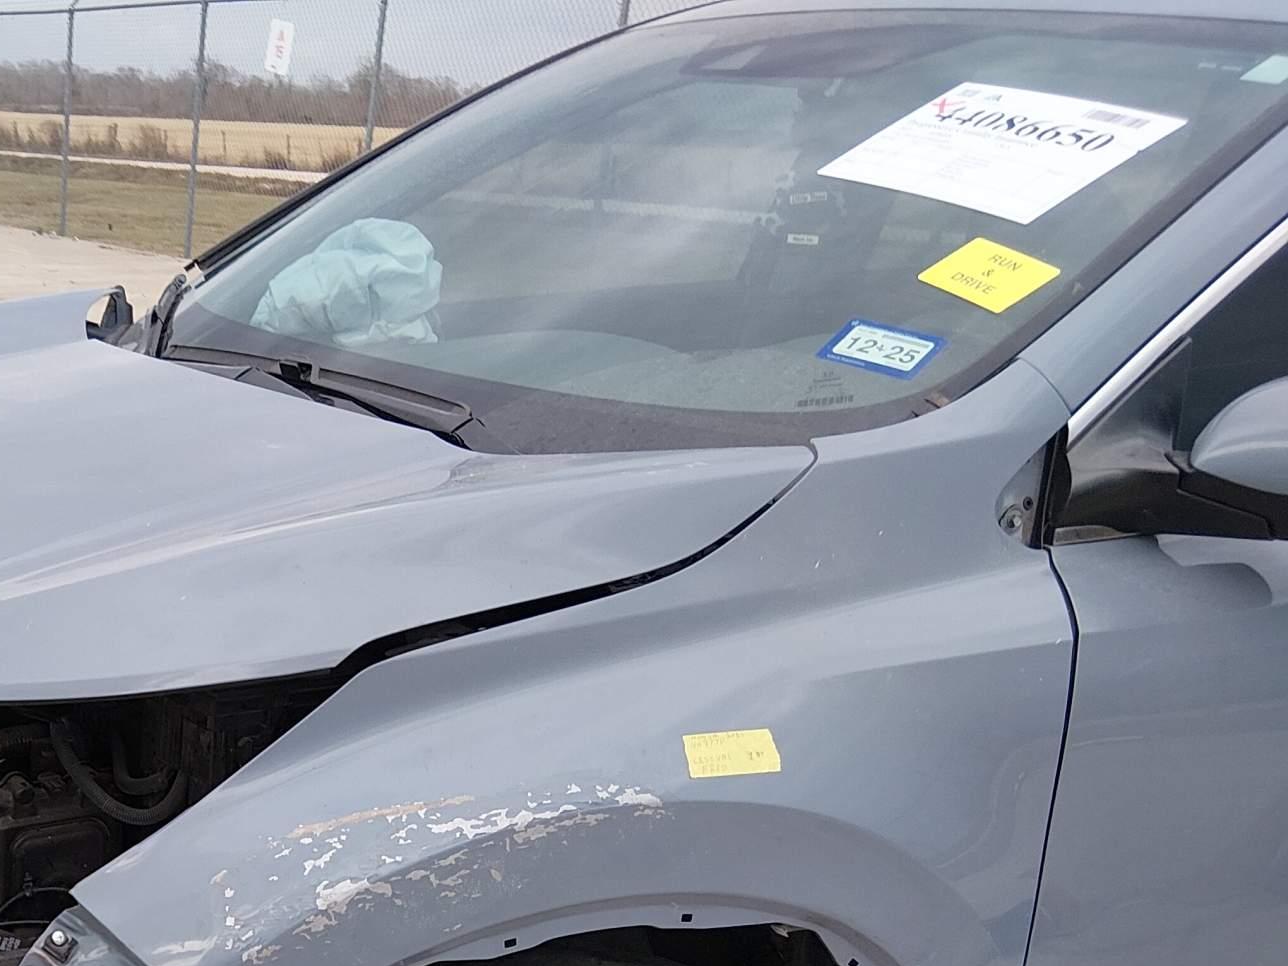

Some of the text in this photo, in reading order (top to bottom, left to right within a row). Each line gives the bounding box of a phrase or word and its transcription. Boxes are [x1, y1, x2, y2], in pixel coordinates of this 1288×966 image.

[935, 106, 1115, 152] 44086650
[981, 268, 995, 278] &
[987, 254, 1024, 273] RUN
[950, 271, 997, 295] DRIVE
[845, 336, 878, 354] 12
[882, 345, 921, 364] 25
